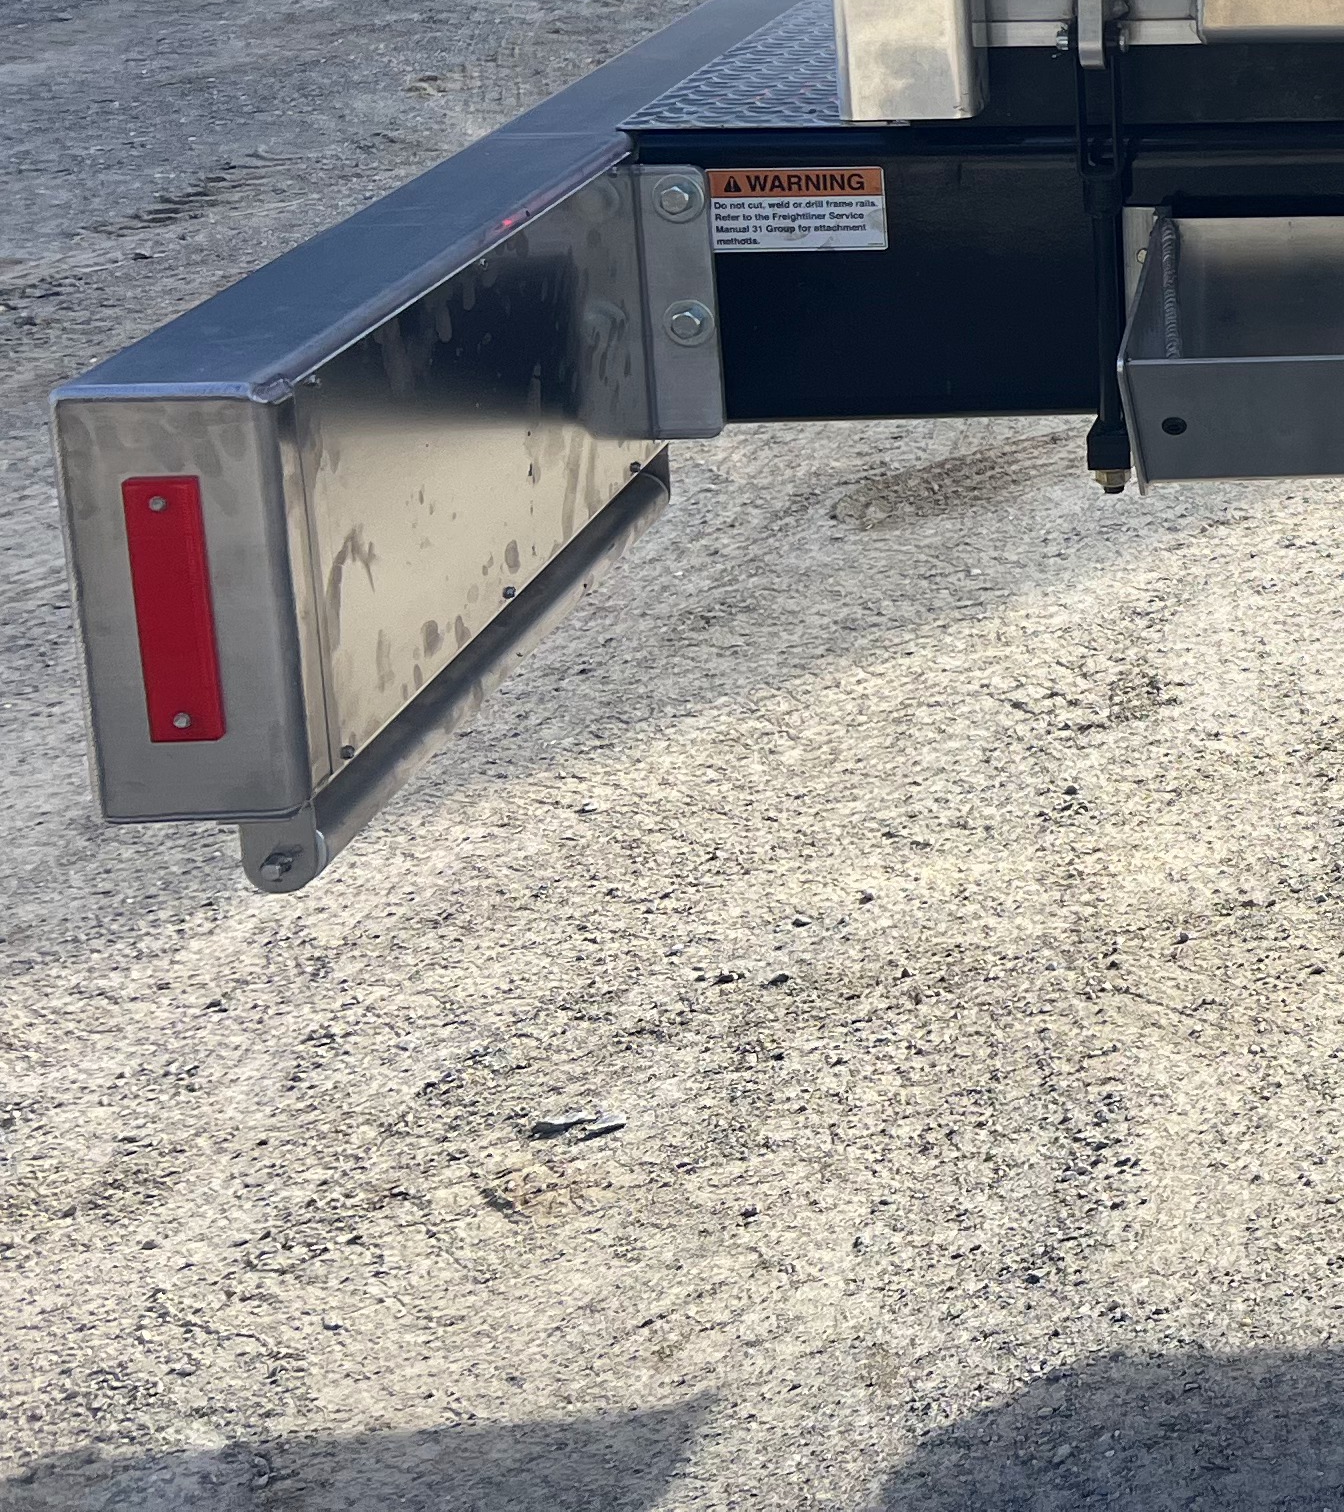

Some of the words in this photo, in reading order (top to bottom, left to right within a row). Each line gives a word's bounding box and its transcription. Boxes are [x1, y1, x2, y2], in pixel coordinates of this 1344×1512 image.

[745, 173, 866, 192] WARNING
[714, 201, 728, 210] Do
[729, 201, 746, 210] not
[768, 200, 790, 209] weld
[805, 200, 824, 208] drill
[826, 200, 854, 208] frame
[715, 213, 741, 221] Refer
[742, 213, 753, 221] to
[754, 213, 770, 221] the
[772, 212, 826, 222] Freightliner
[829, 211, 865, 220] Service
[716, 225, 750, 233] Manual
[752, 225, 763, 233] 31
[765, 224, 796, 234] Group
[798, 224, 812, 232] for
[813, 223, 867, 232] attachment
[716, 237, 761, 246] methods.
